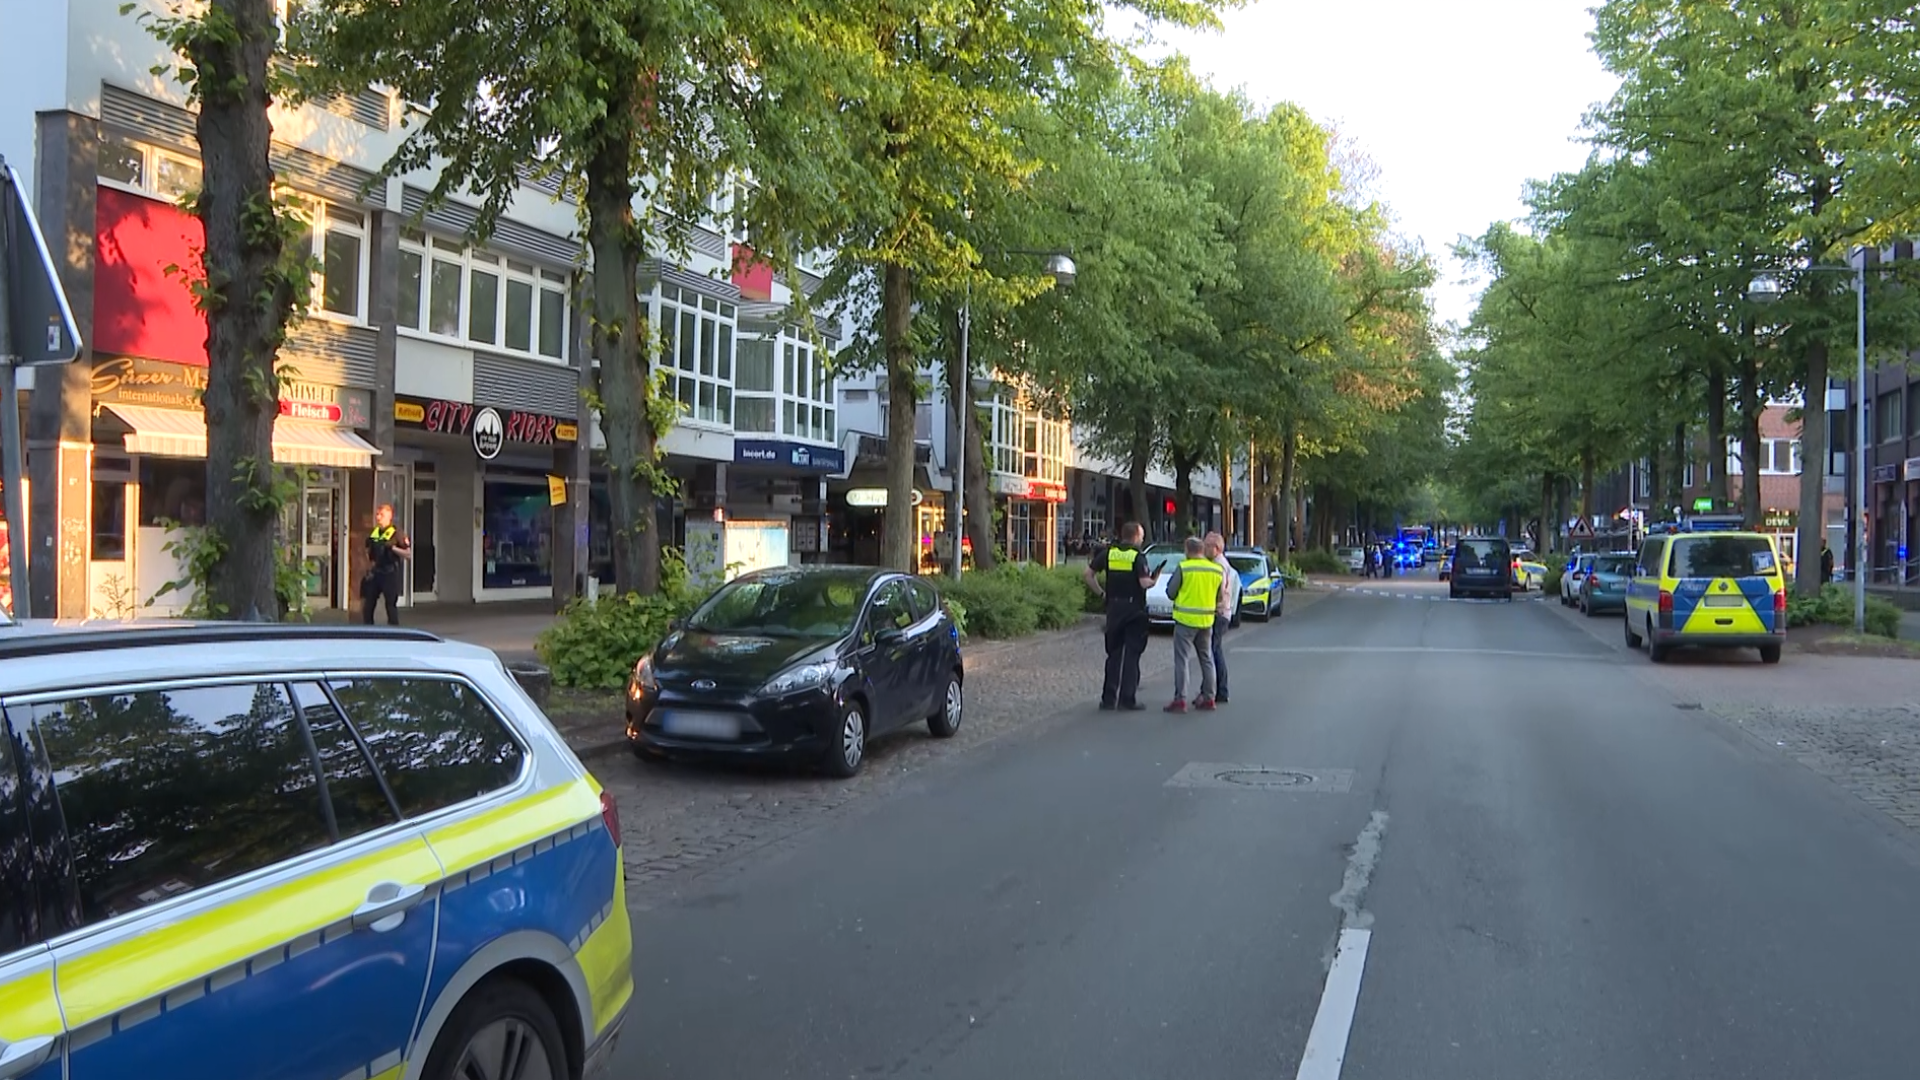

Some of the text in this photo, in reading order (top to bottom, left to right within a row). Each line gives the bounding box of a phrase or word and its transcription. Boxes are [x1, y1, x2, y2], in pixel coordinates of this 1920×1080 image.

[119, 387, 183, 406] internationale
[291, 403, 330, 419] Fleisch
[426, 400, 474, 435] CITY
[507, 411, 556, 445] KIOSK
[1765, 518, 1790, 527] DEVK
